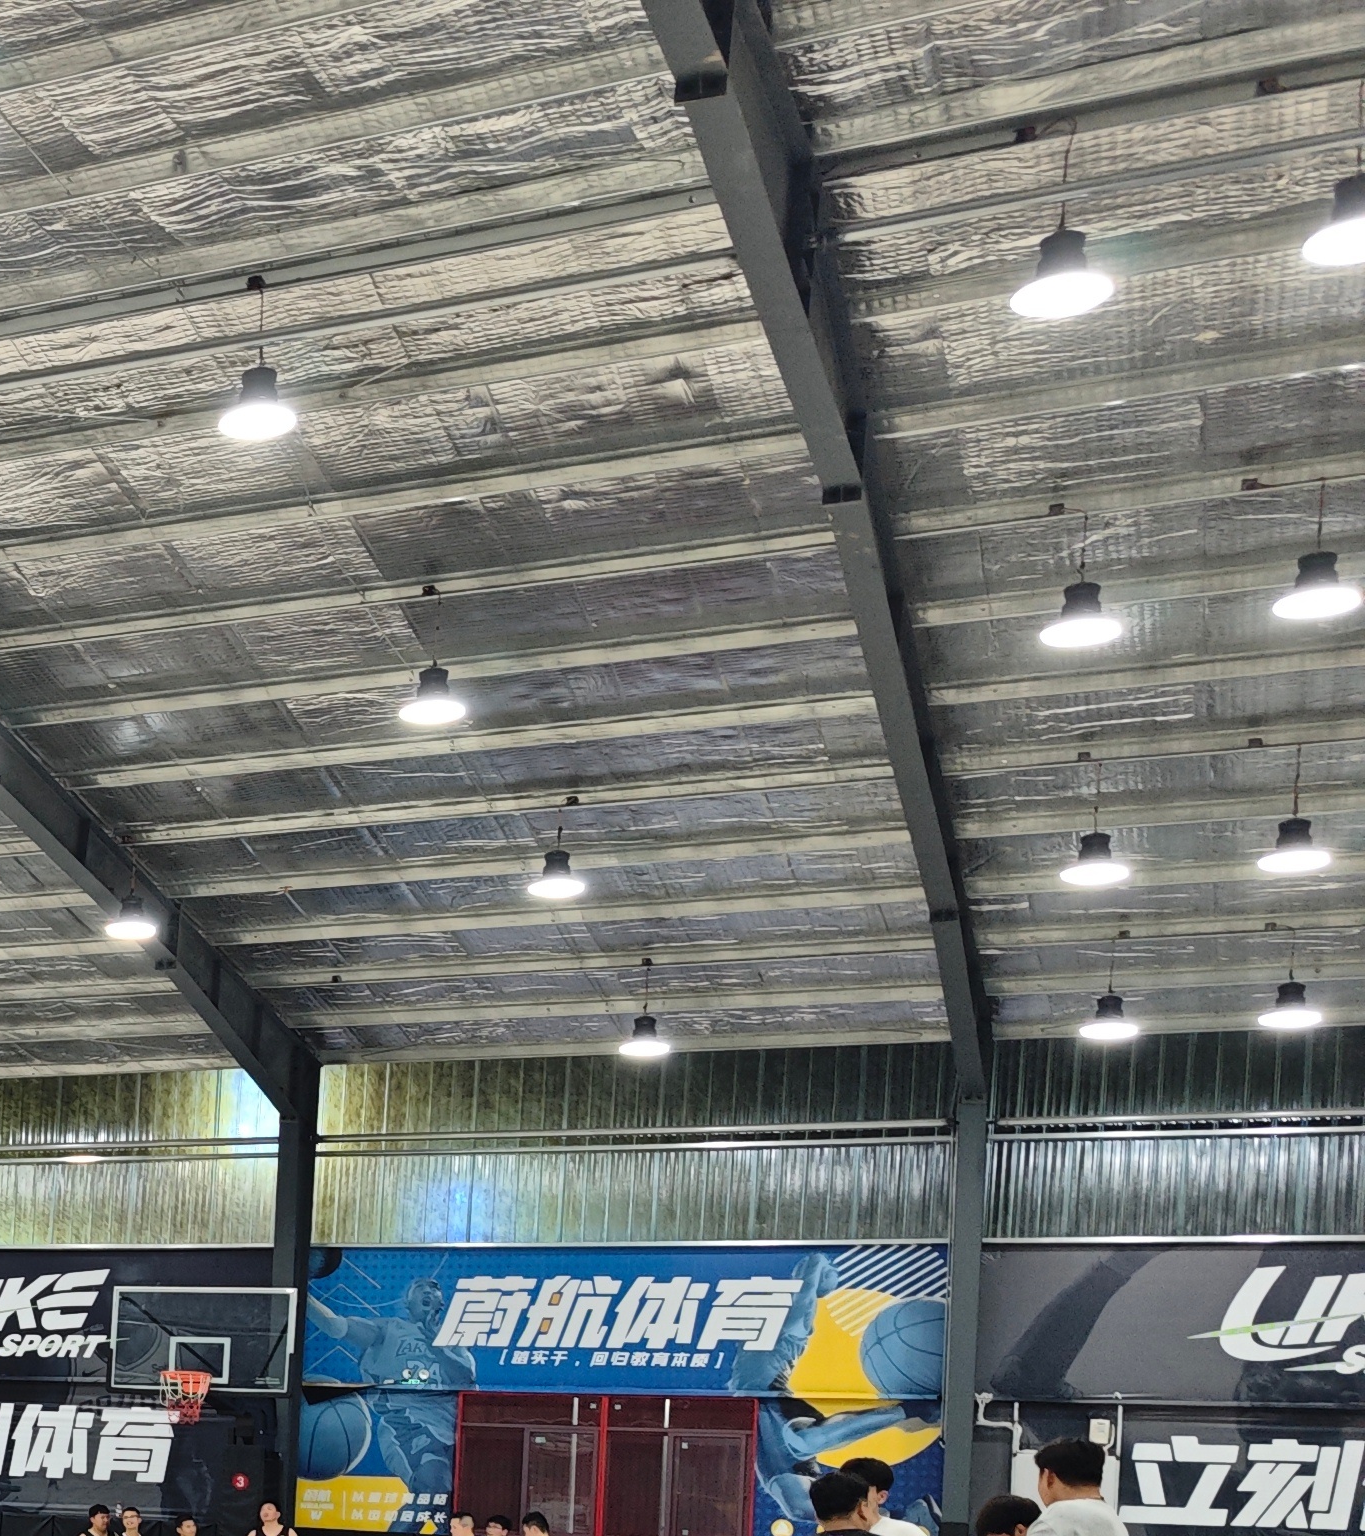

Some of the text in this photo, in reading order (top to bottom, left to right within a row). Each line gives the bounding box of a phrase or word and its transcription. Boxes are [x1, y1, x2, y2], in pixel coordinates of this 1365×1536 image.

[432, 1275, 804, 1351] 蔚航体育
[1119, 1434, 1365, 1531] 立刻
